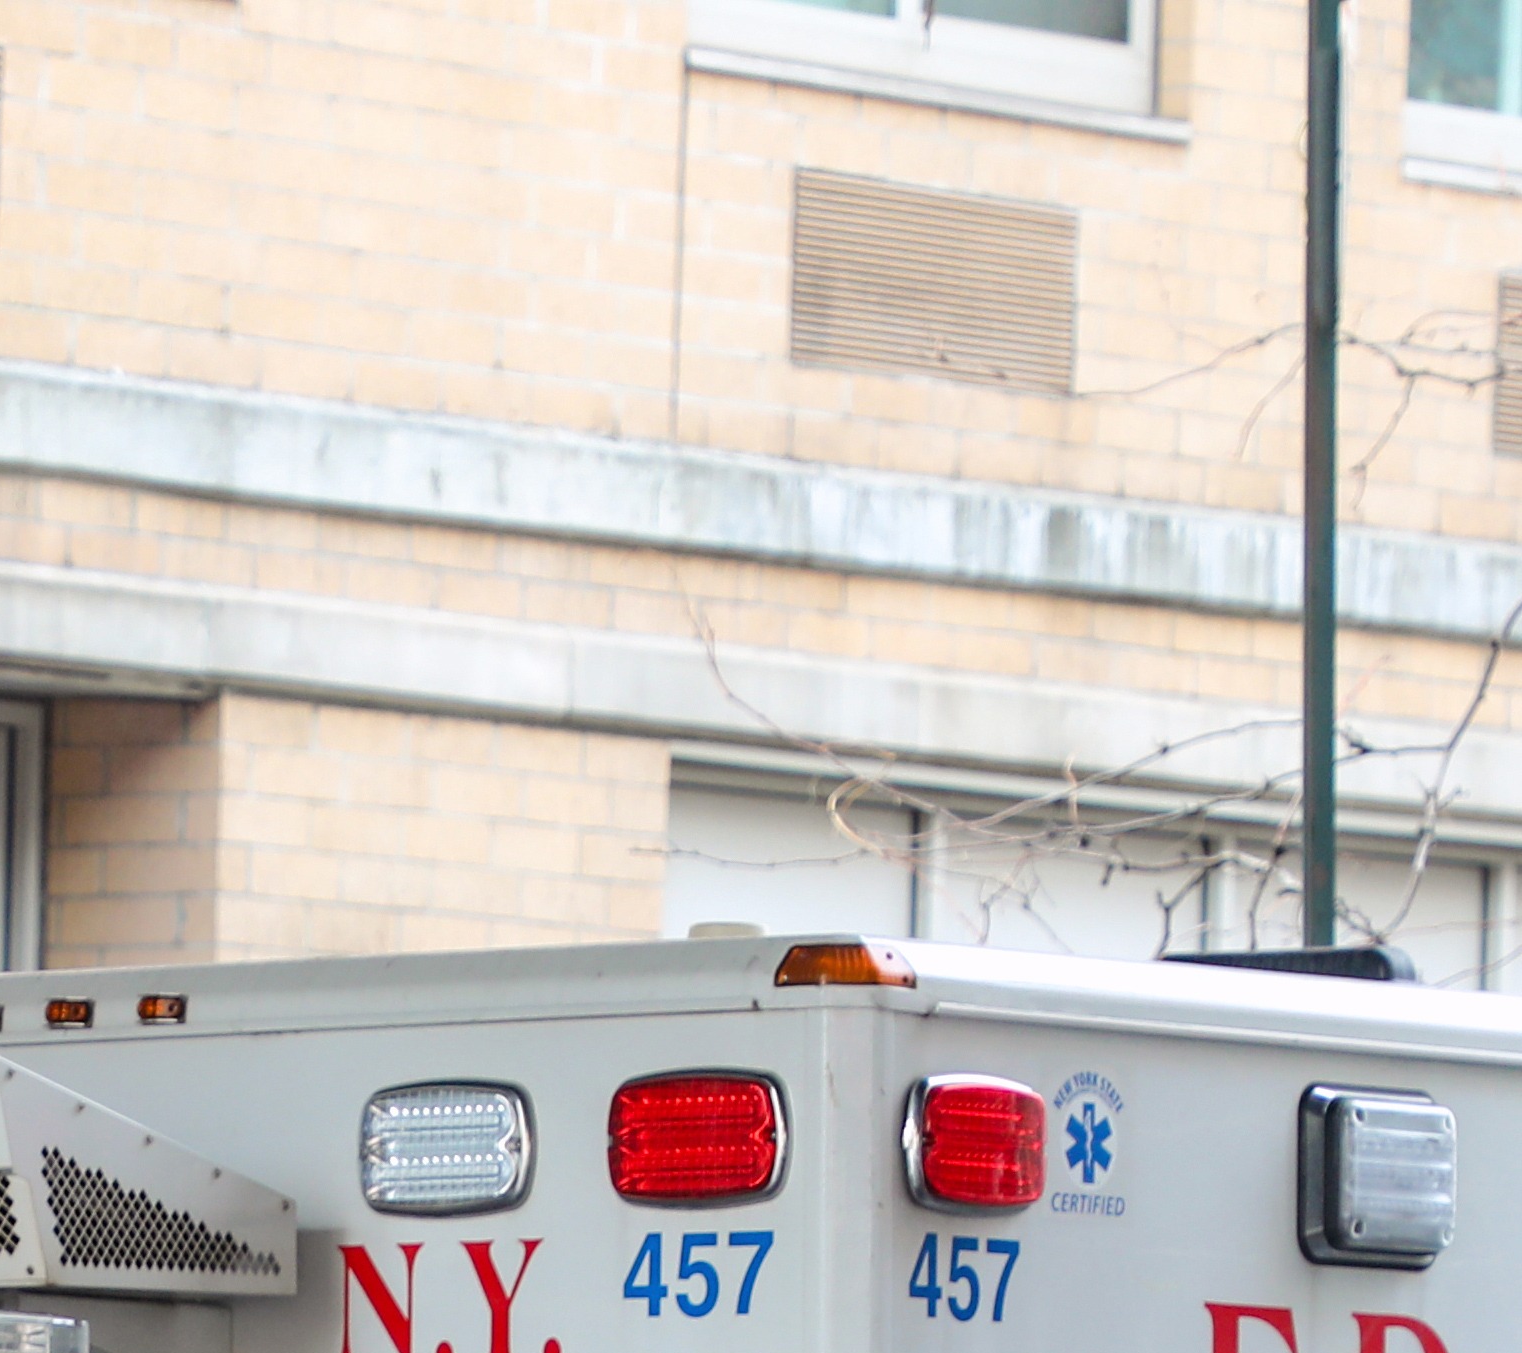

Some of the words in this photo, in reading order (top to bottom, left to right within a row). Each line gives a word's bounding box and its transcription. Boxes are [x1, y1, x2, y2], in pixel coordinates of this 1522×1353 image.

[1054, 1079, 1072, 1110] NEW
[1051, 1192, 1125, 1216] CERTIFIED
[623, 1230, 775, 1318] 457
[908, 1232, 1021, 1322] 457
